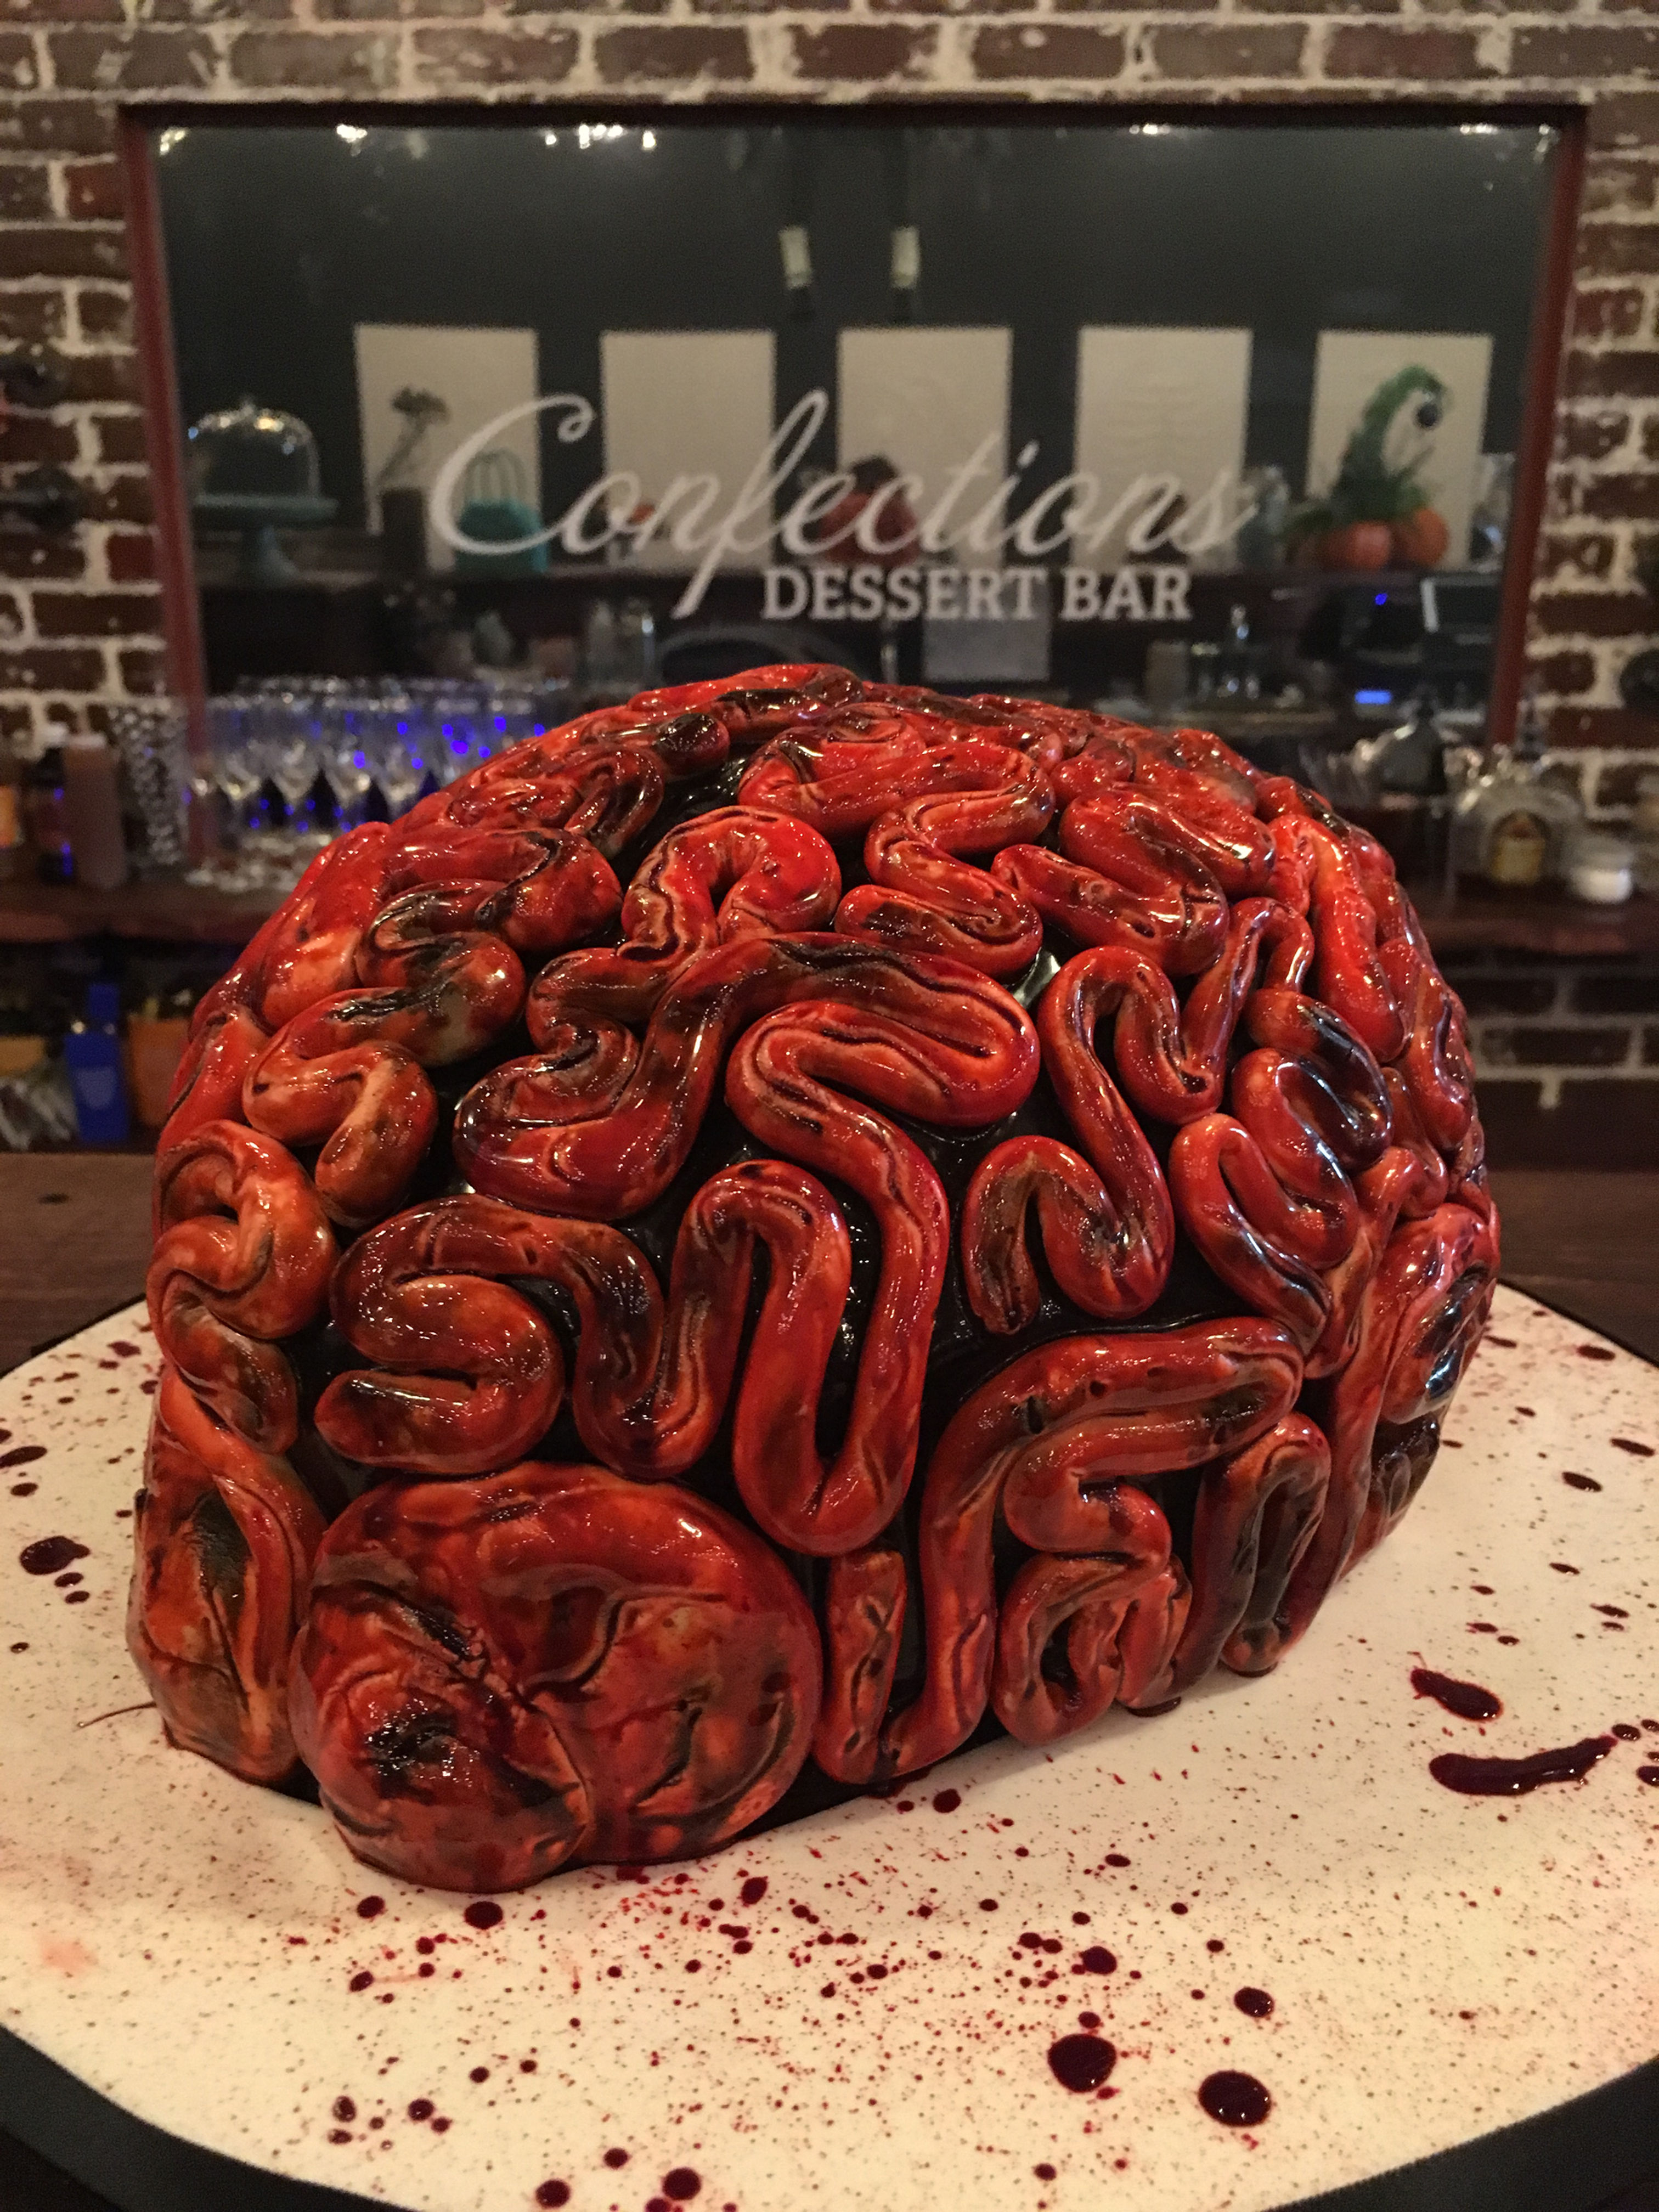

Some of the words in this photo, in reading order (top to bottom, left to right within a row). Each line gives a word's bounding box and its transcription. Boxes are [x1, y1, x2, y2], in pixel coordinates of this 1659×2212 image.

[430, 389, 1257, 619] Confections
[763, 567, 1046, 620] DESSERT
[1062, 567, 1193, 620] BAR
